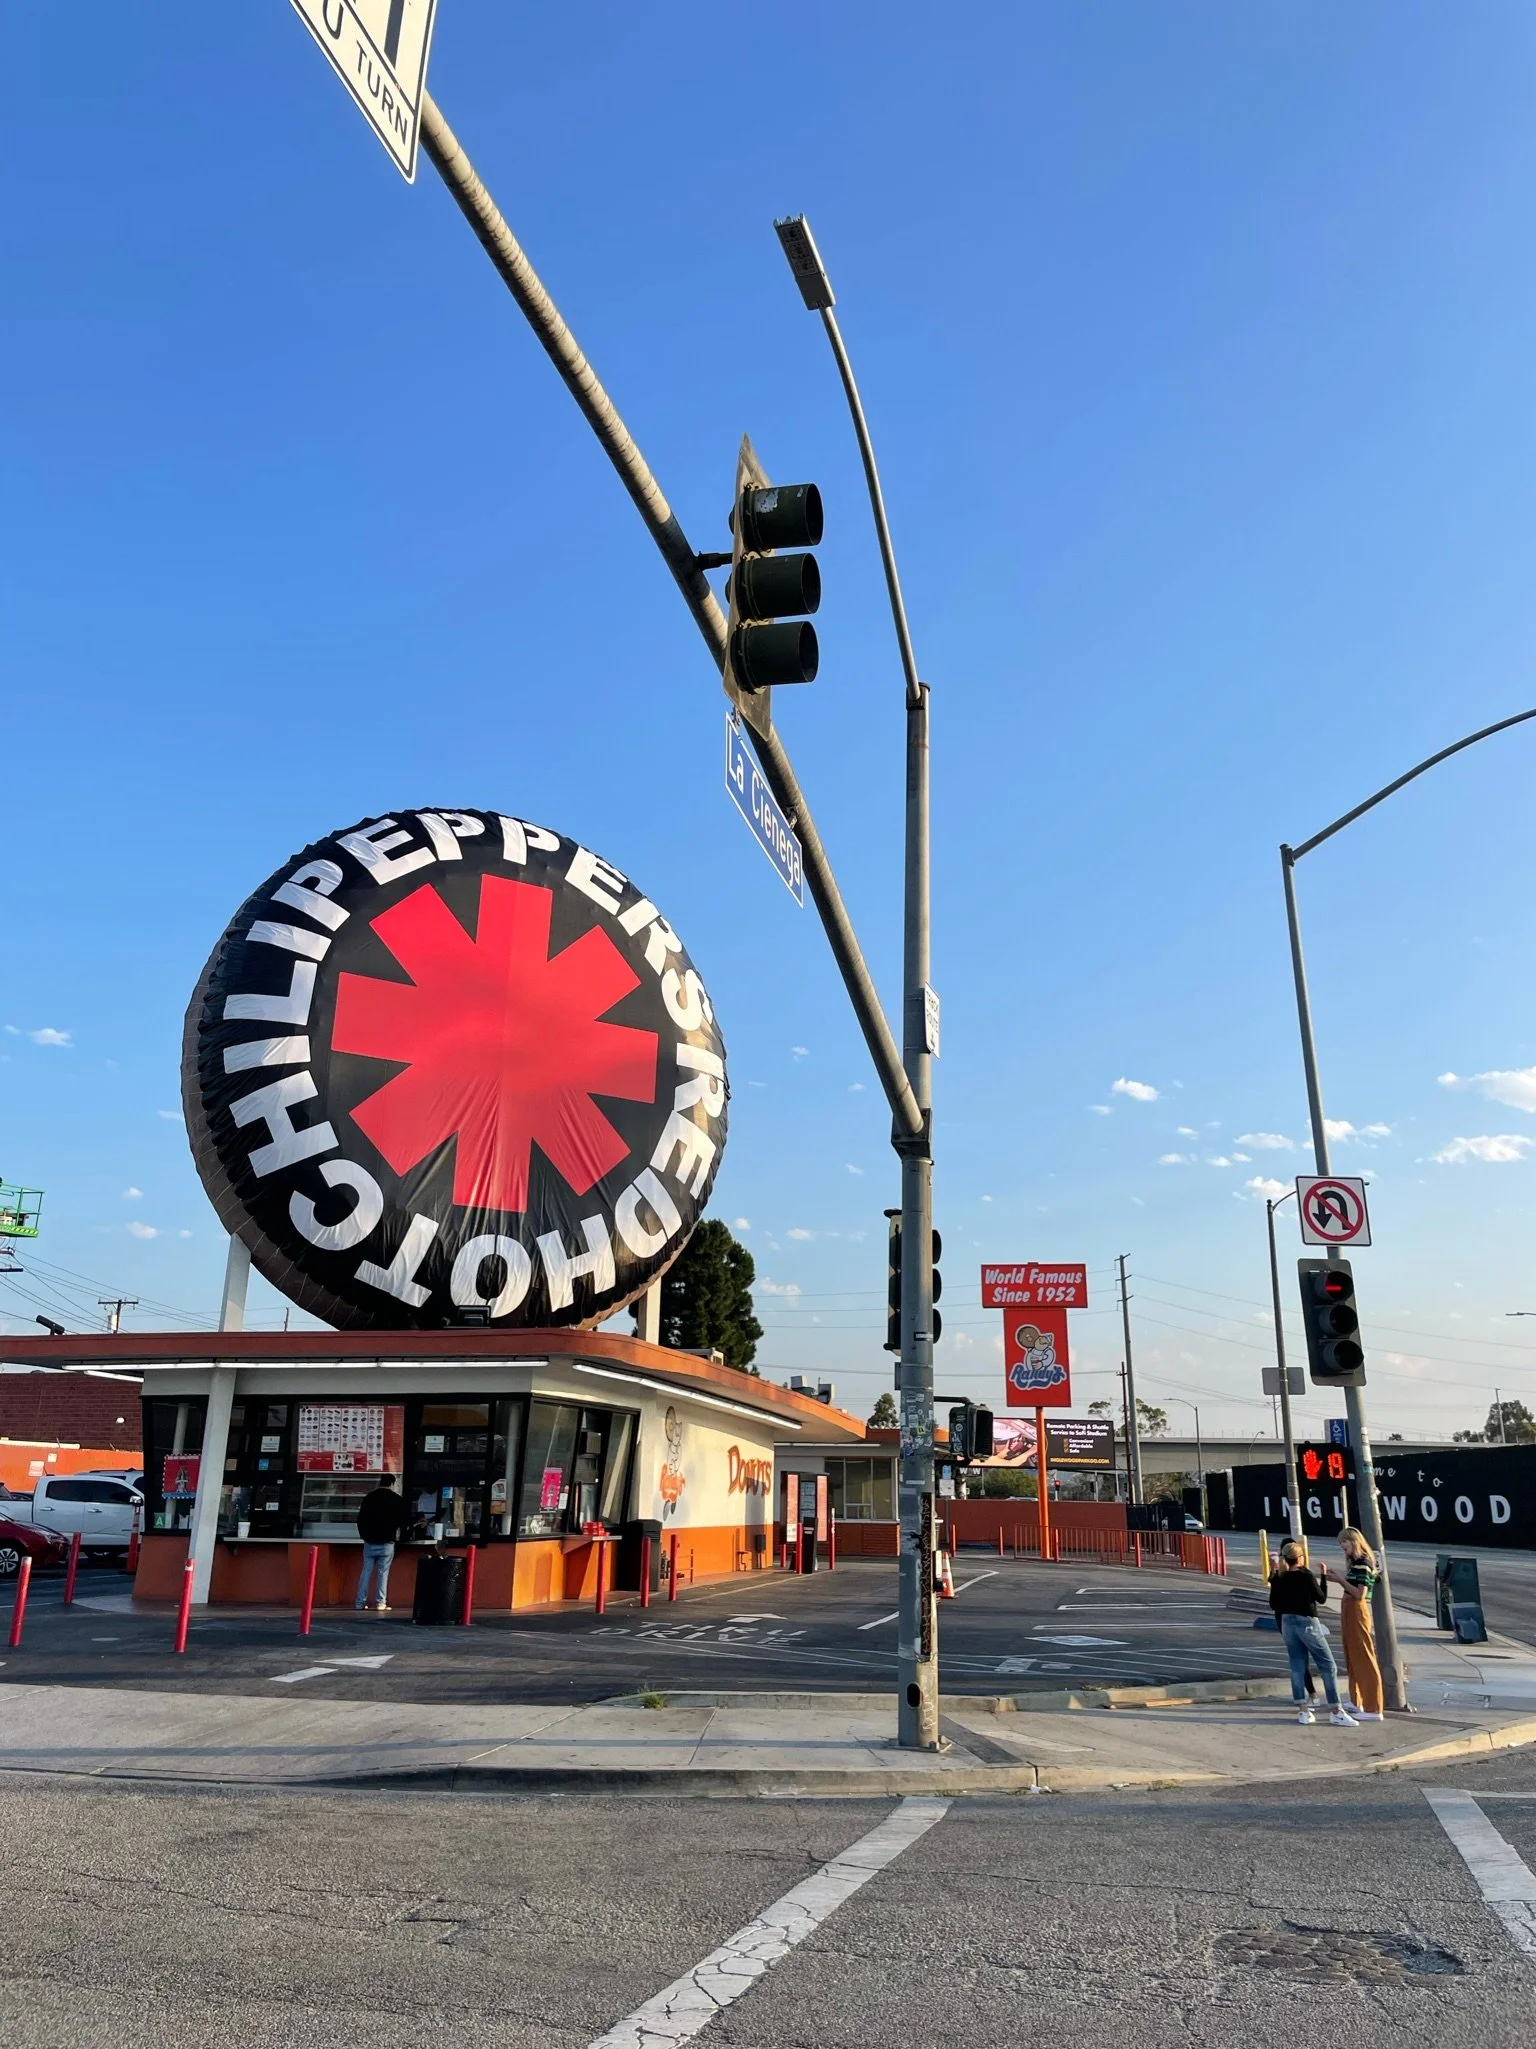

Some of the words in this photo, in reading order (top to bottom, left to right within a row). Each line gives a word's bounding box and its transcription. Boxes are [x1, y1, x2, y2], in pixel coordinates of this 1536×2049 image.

[355, 39, 409, 146] TURN
[728, 720, 744, 795] La
[751, 769, 801, 887] Cienega
[271, 811, 715, 1032] PEPPERS
[221, 918, 384, 1251] CHILI
[613, 1042, 727, 1258] RED
[353, 1212, 617, 1318] HOT
[985, 1268, 1026, 1284] World
[1029, 1268, 1083, 1284] Famous
[992, 1287, 1031, 1303] Since
[1036, 1286, 1076, 1302] 1952
[1011, 1364, 1066, 1389] Randy's
[155, 1515, 164, 1527] A
[1263, 1494, 1512, 1525] INGLWOOD
[588, 1627, 803, 1646] DRIVE
[639, 1621, 808, 1637] THRU
